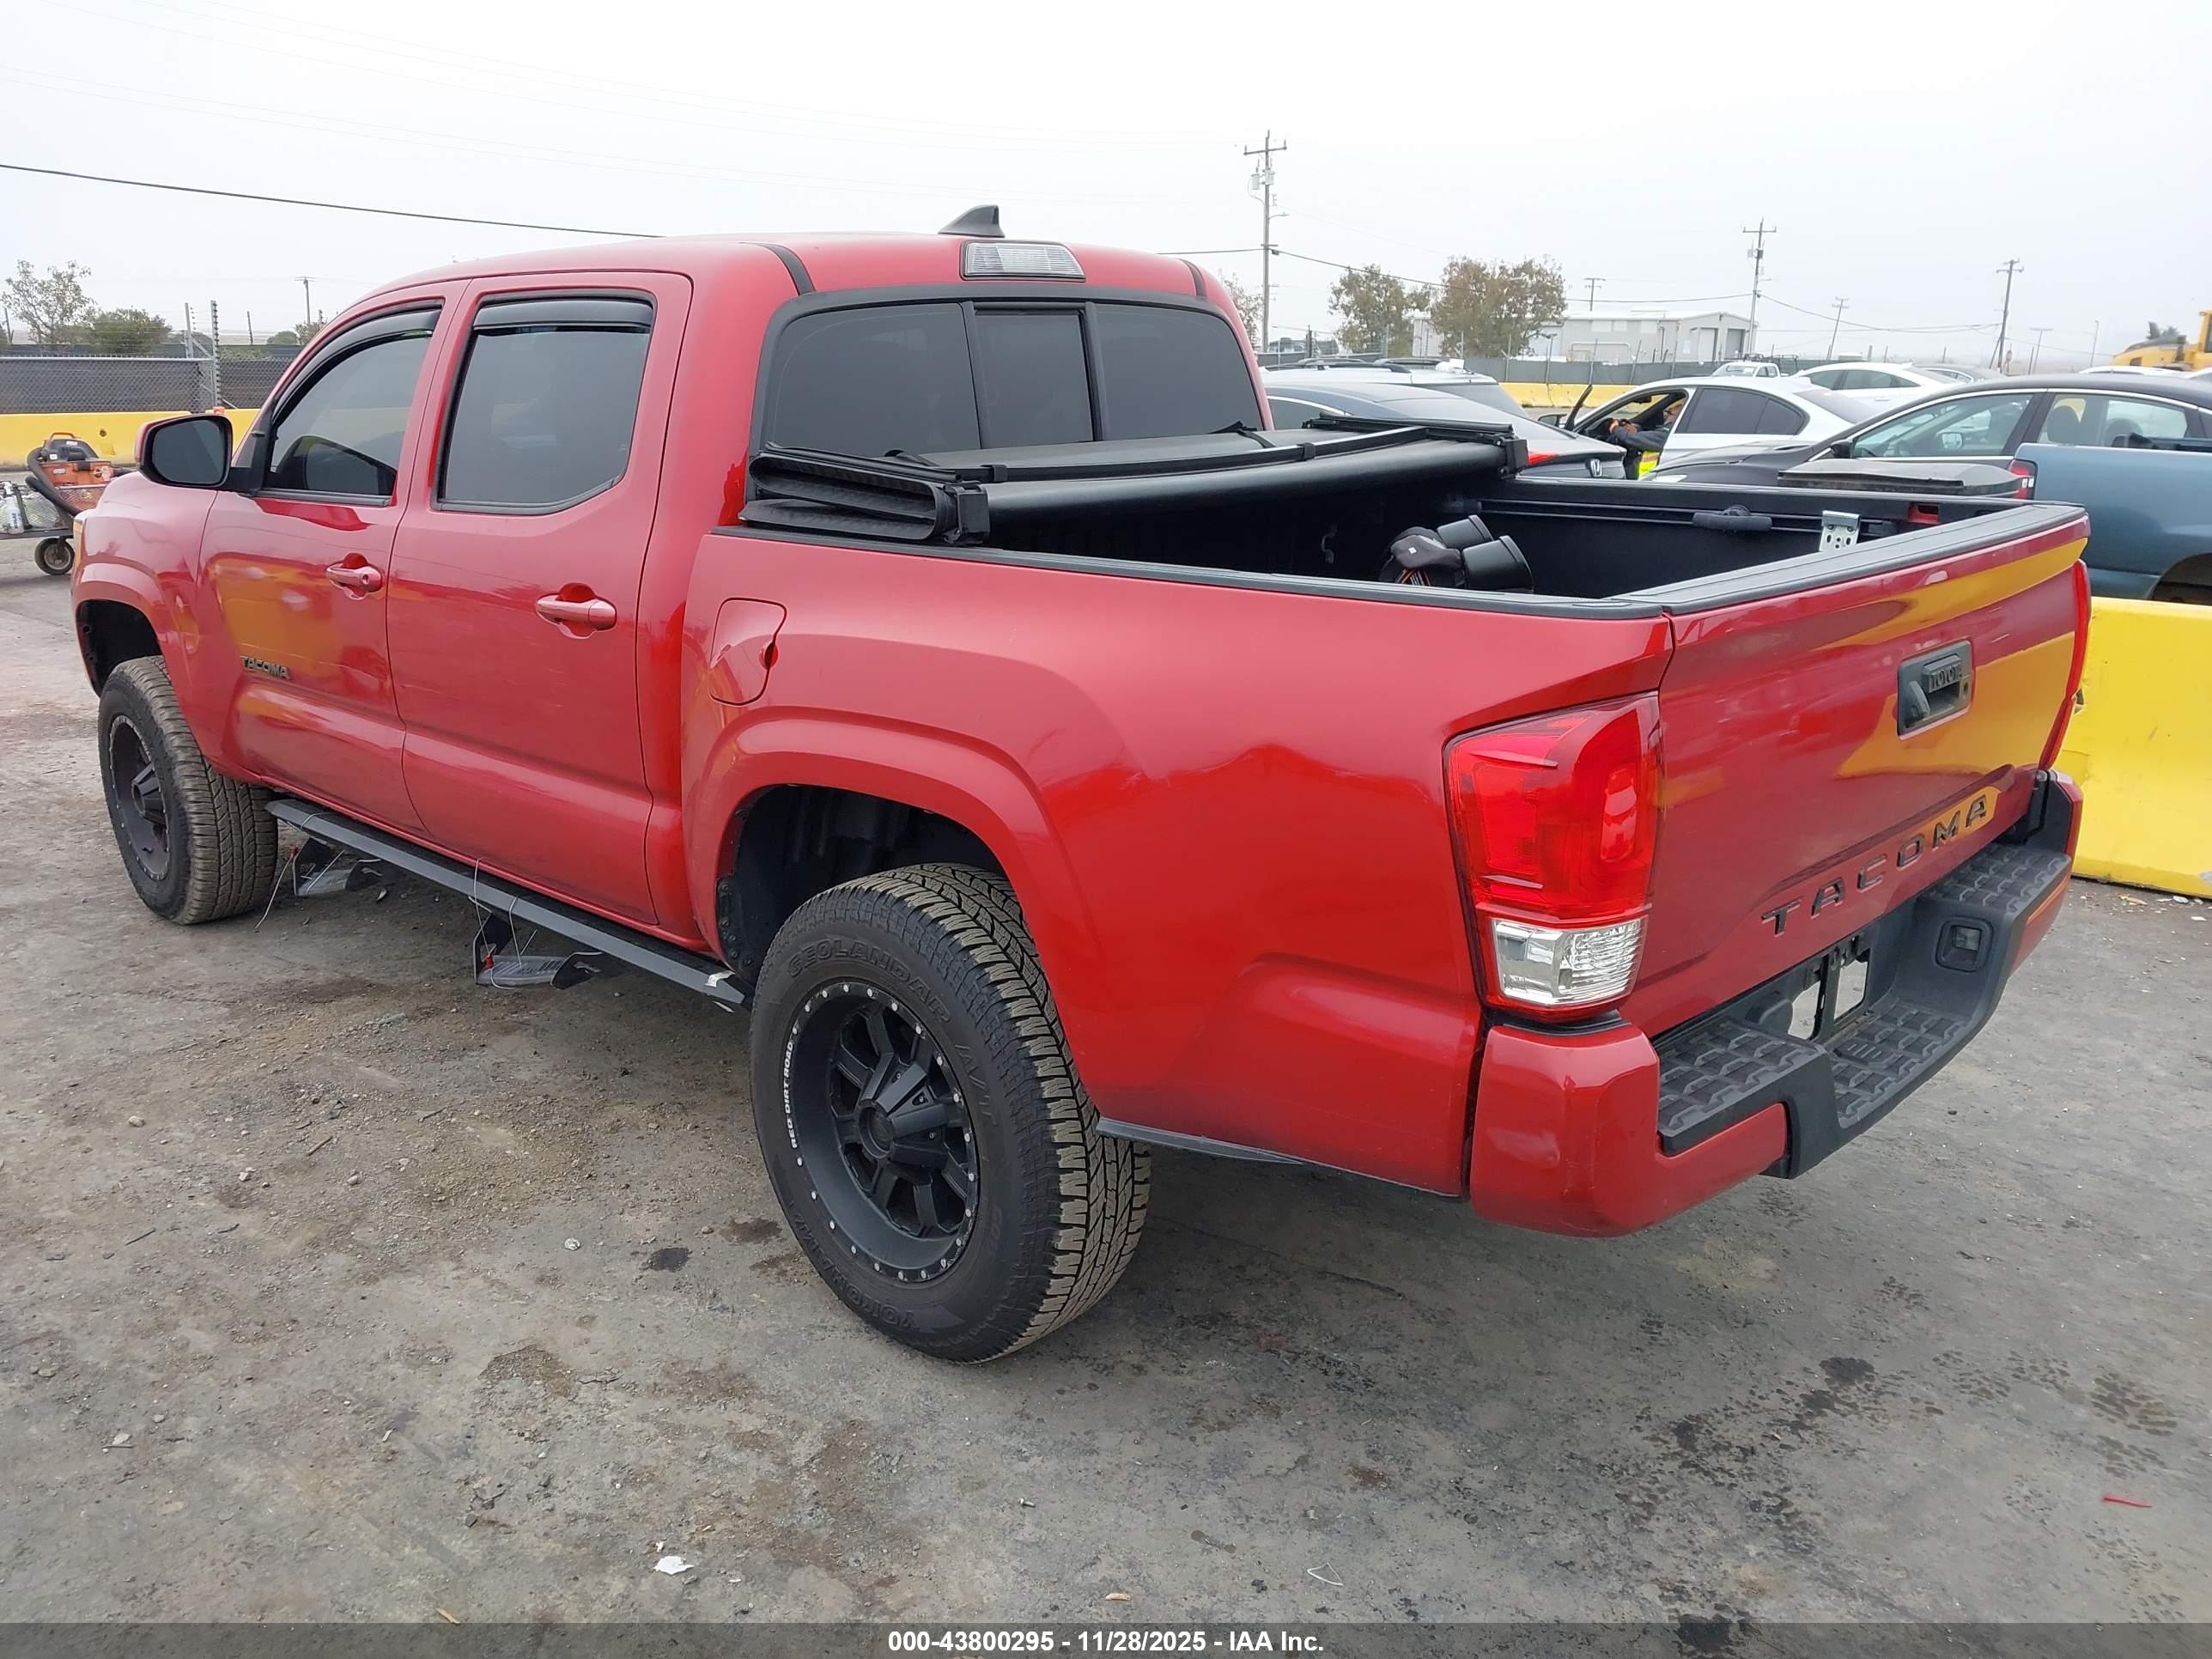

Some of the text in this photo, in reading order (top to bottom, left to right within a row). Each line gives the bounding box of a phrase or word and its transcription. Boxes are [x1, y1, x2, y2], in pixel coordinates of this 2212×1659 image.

[240, 655, 291, 680] TACOMA
[1760, 793, 1988, 938] TACOMA
[788, 937, 953, 1024] GEOLANDAR
[783, 1041, 793, 1078] ROAD
[787, 1117, 798, 1149] RED
